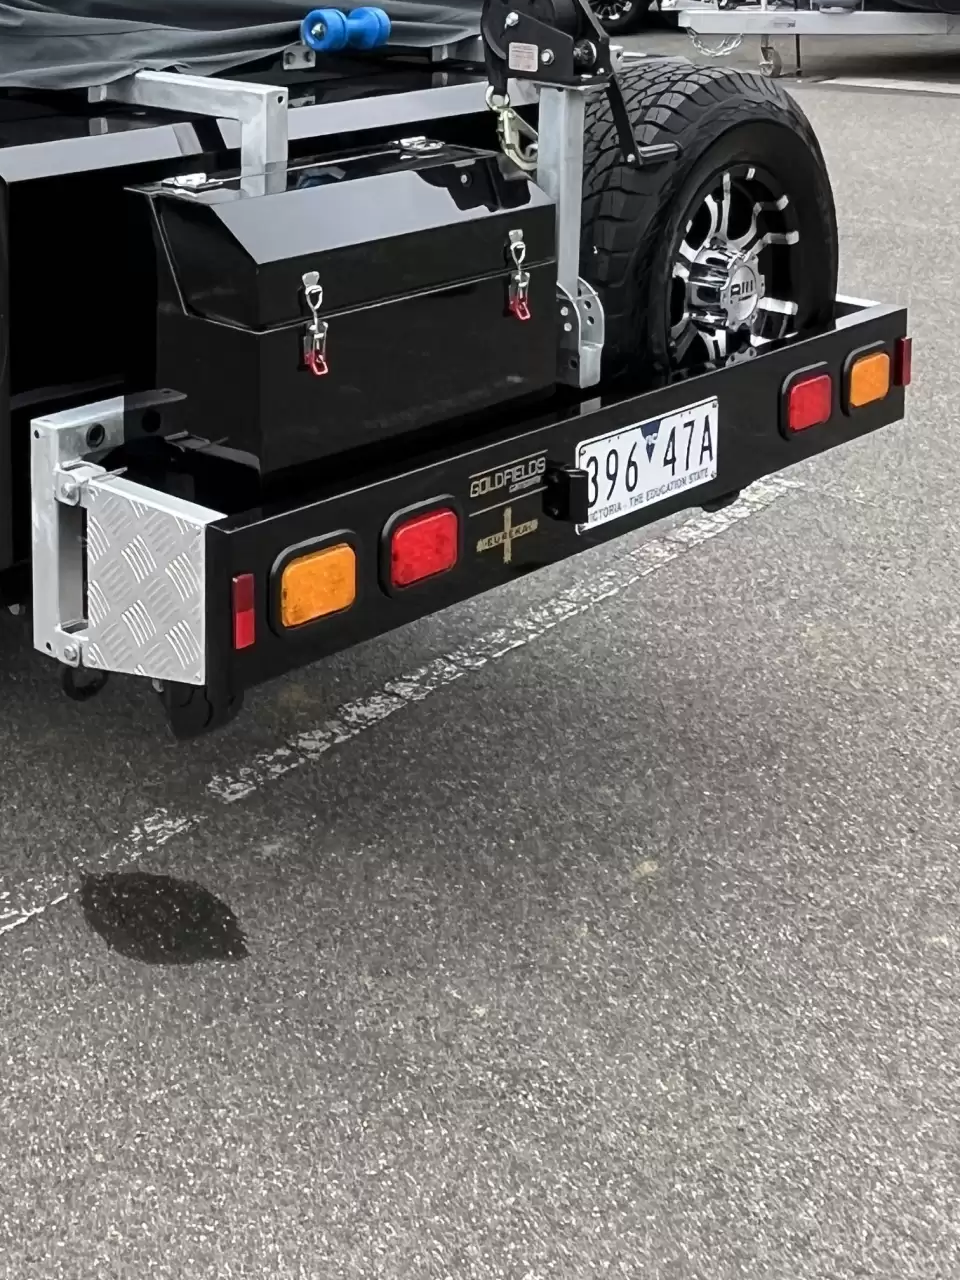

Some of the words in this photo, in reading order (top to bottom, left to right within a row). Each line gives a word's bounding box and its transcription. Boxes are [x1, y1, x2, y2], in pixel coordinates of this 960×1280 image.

[470, 456, 546, 498] GOLDFIELDS
[586, 441, 638, 508] 396
[663, 414, 714, 476] 47A
[646, 476, 687, 501] EDUCATION
[688, 467, 708, 484] STATE
